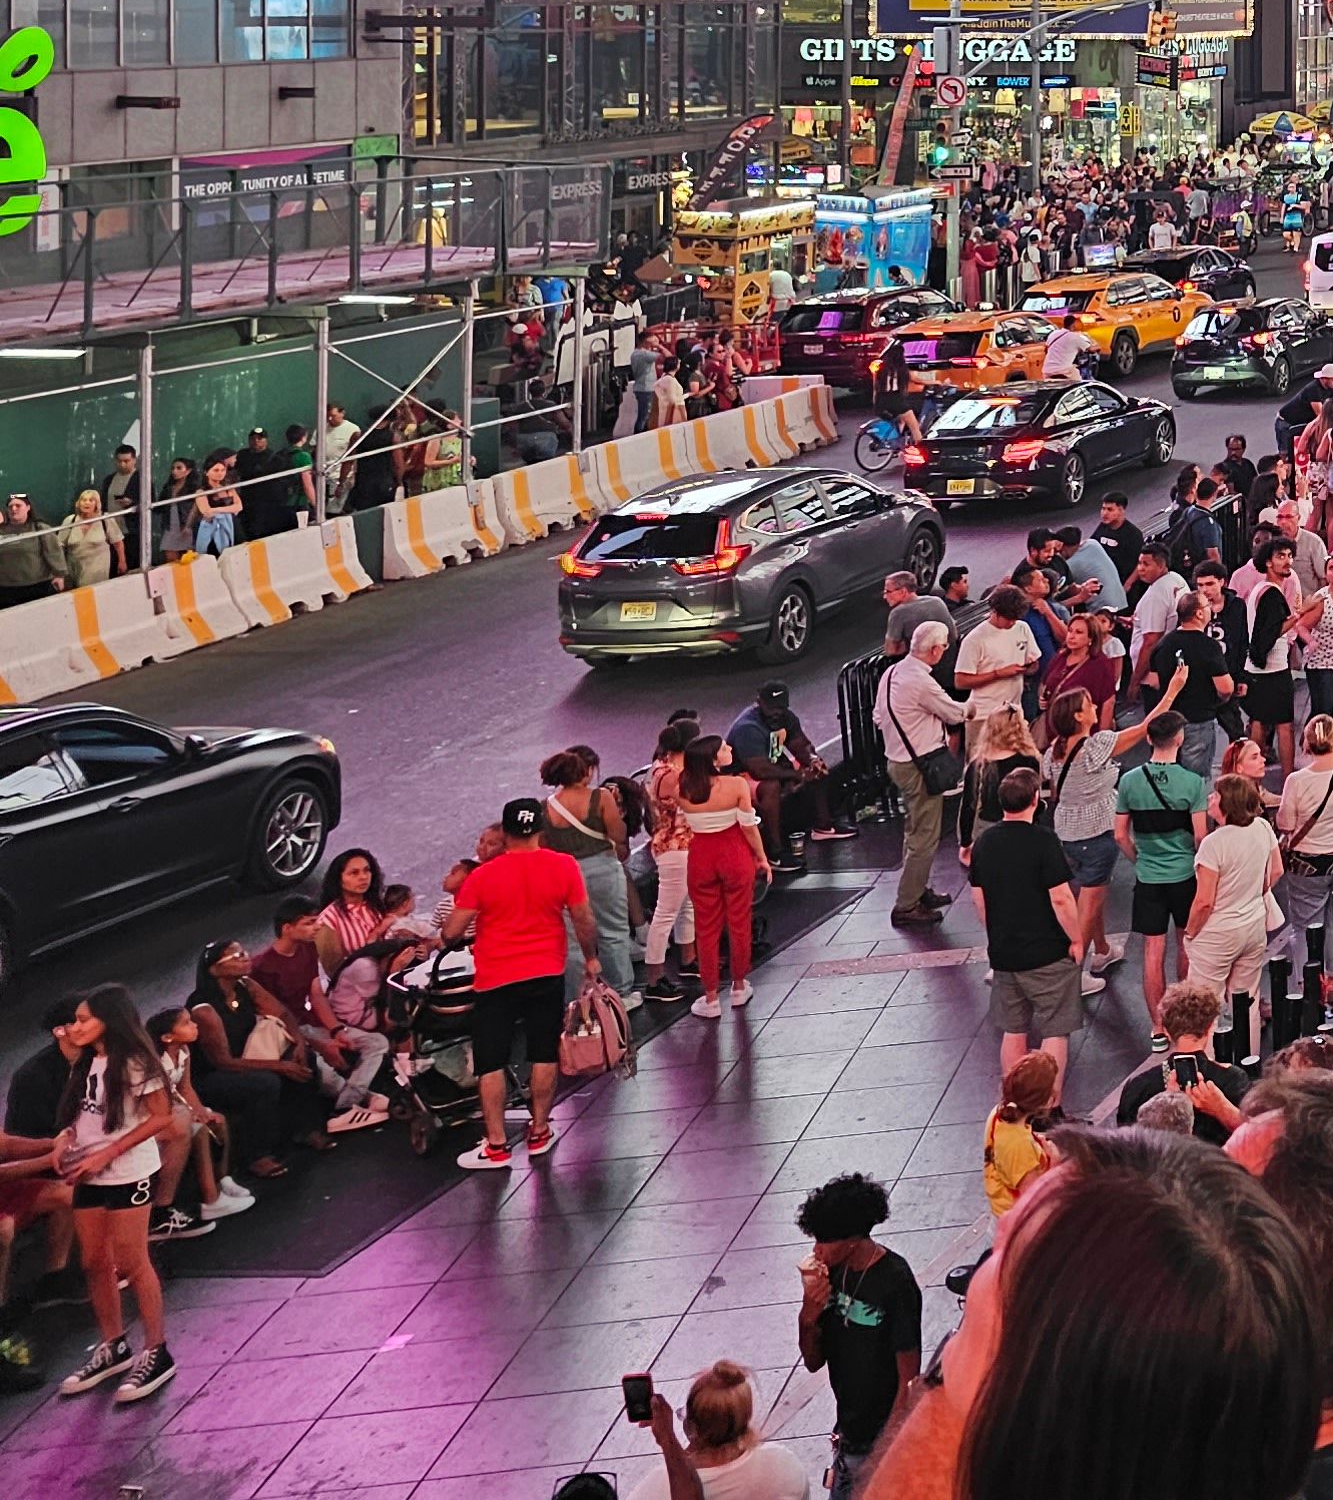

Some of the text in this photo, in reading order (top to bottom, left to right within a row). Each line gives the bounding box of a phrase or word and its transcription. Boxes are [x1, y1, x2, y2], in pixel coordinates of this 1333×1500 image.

[1186, 36, 1230, 55] LUGGAGE
[814, 76, 837, 88] Apple
[996, 76, 1031, 87] BOWER
[184, 173, 296, 199] THE OF
[551, 180, 603, 201] EXPRESS
[628, 172, 675, 191] EXPRESS
